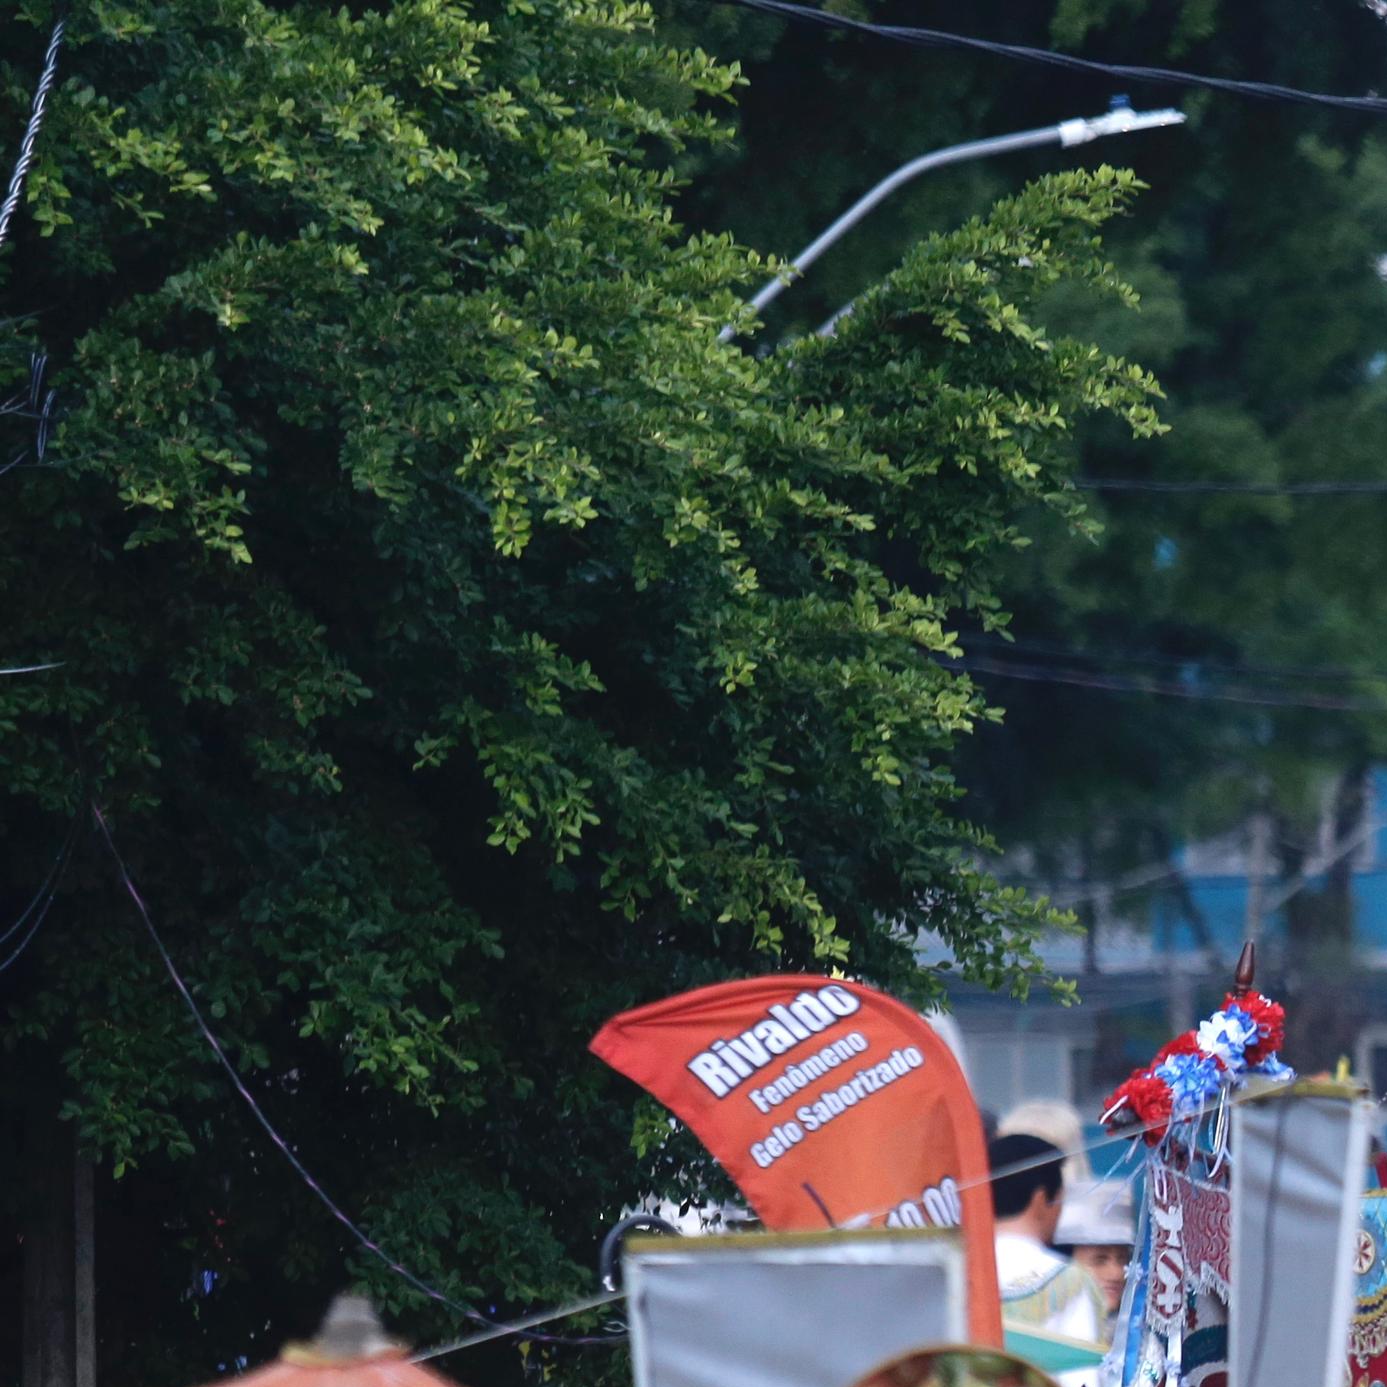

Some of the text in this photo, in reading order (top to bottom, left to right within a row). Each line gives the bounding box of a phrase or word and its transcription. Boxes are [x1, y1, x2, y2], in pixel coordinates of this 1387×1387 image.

[687, 984, 862, 1099] Rivaldo
[750, 1046, 925, 1168] Gelo Saborizado
